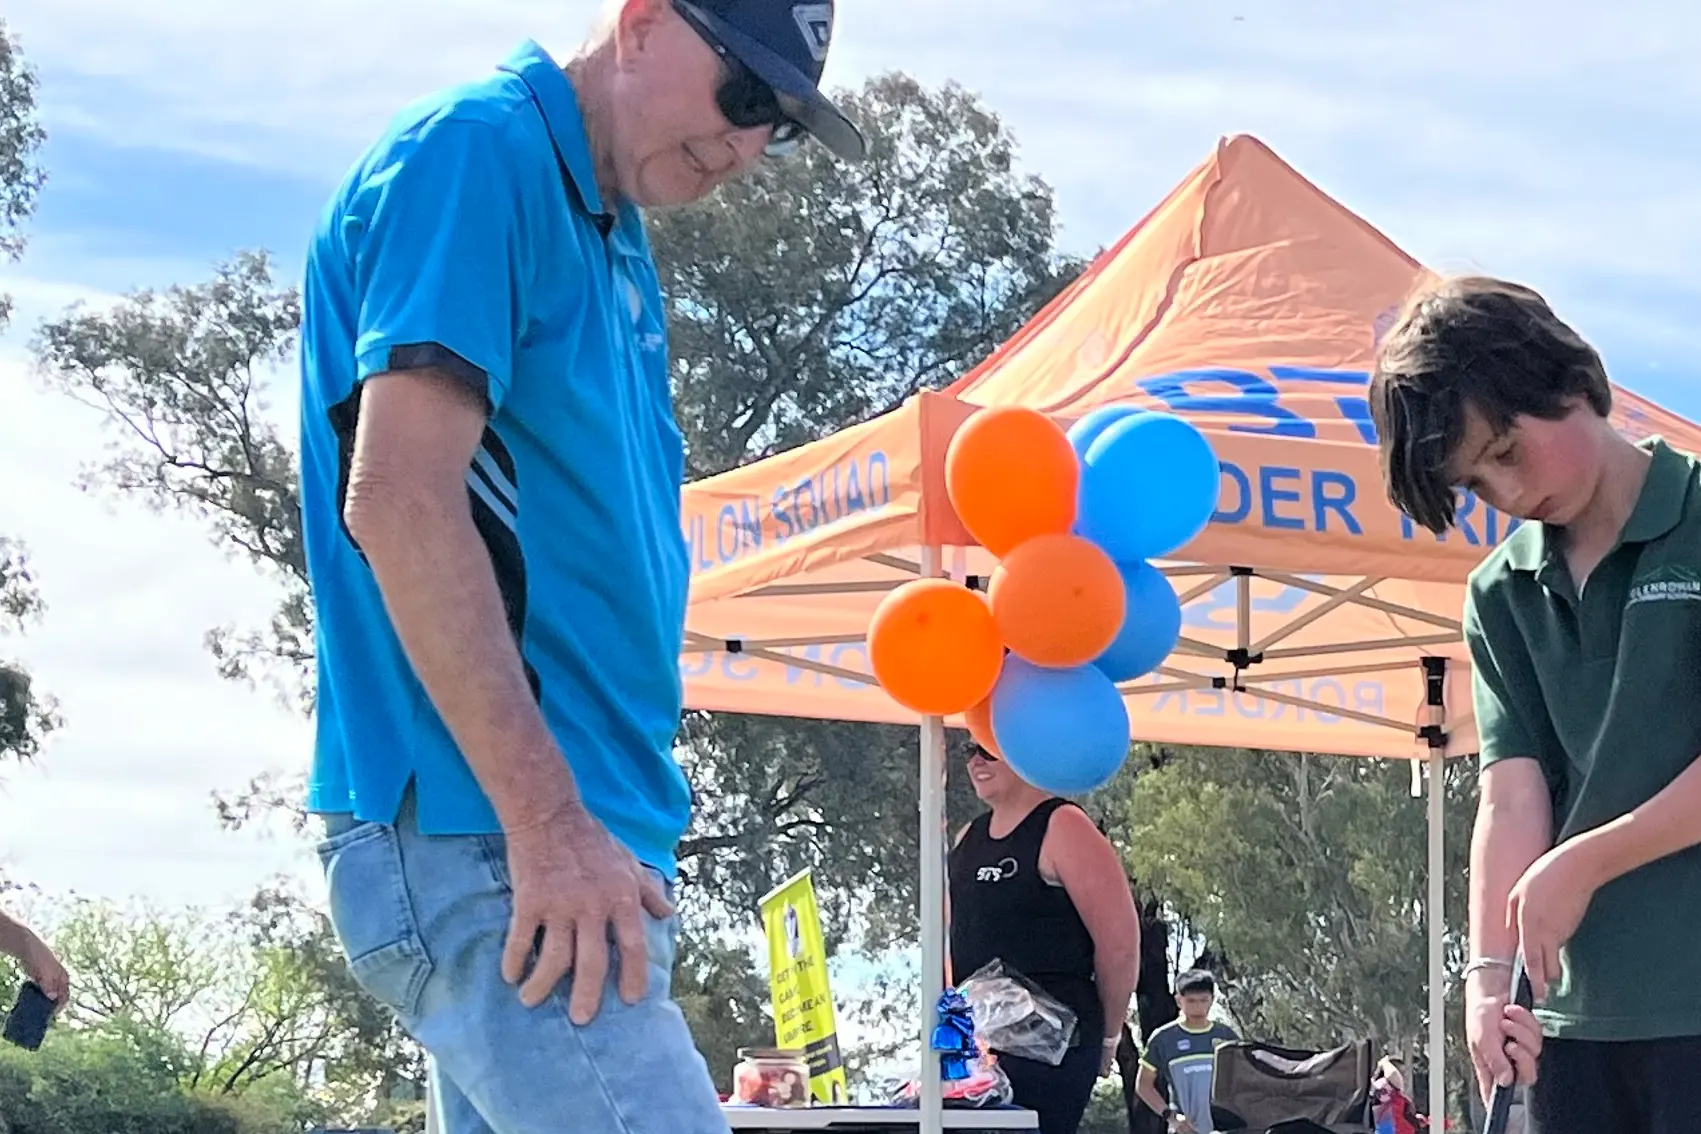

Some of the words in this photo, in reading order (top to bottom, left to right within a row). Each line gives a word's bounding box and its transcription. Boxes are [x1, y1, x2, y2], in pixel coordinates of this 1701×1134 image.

[686, 493, 763, 571] LON
[771, 451, 891, 543] SQUAD
[1212, 460, 1364, 537] DER
